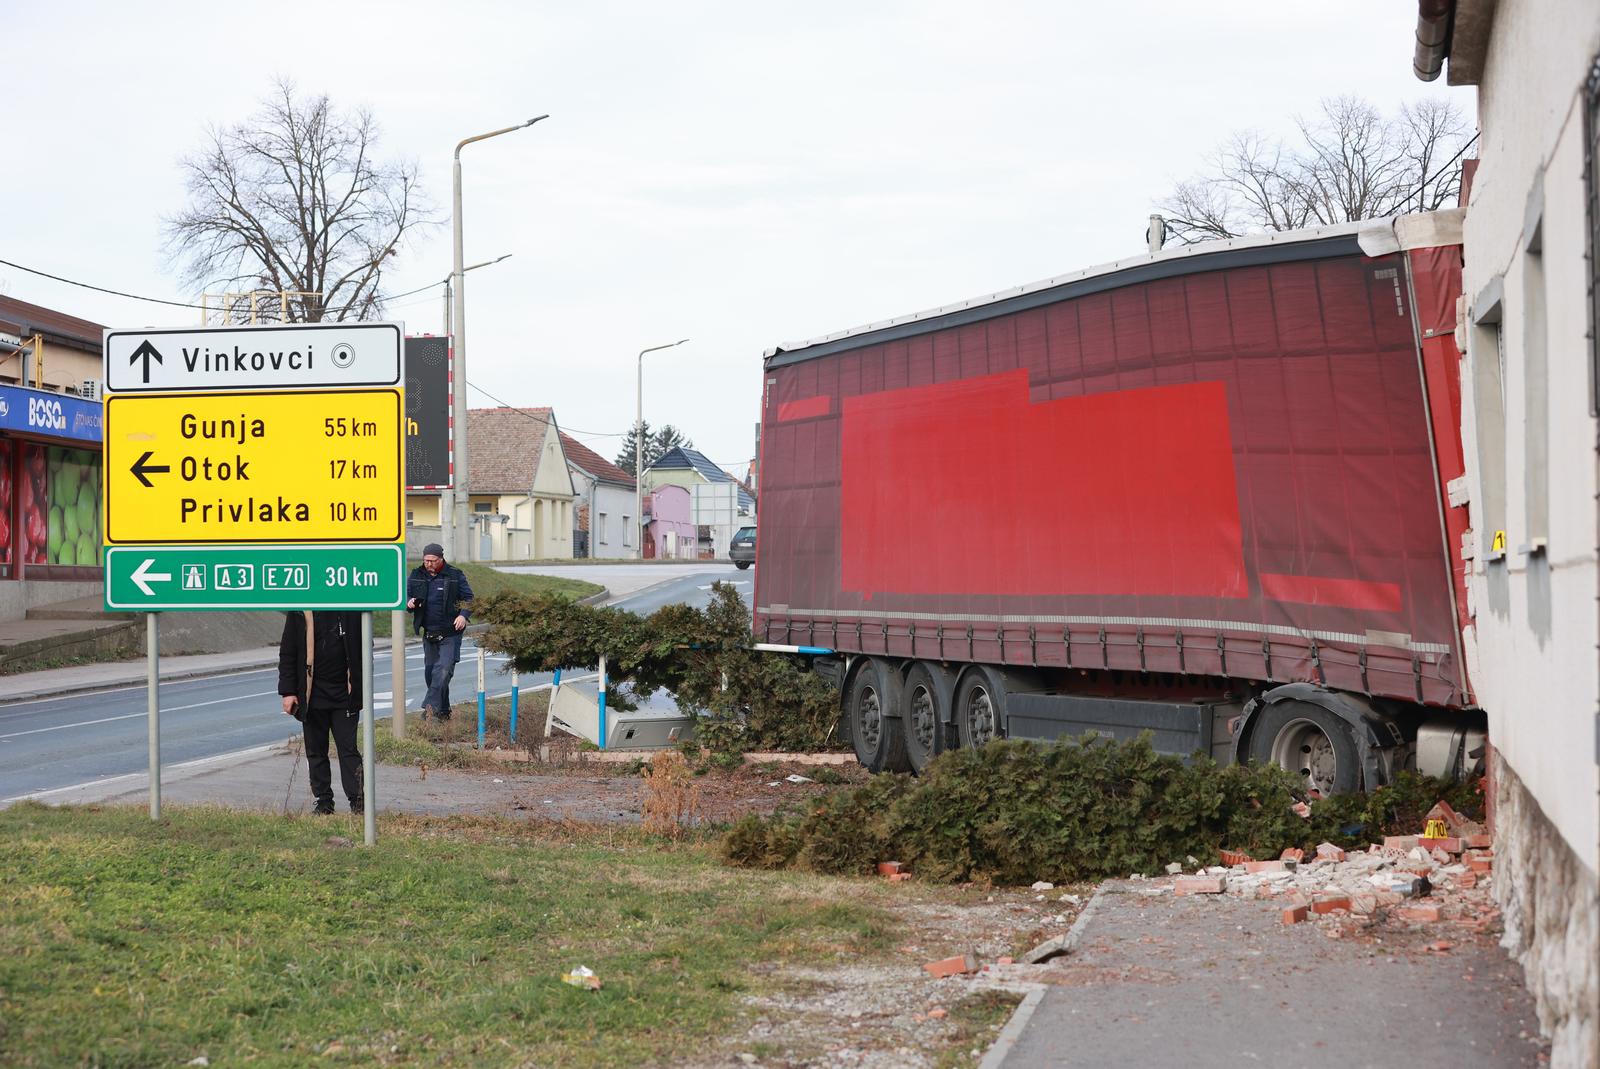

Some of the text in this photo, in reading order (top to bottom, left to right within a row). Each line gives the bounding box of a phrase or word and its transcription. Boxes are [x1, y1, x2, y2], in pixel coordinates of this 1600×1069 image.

[182, 345, 313, 372] Vinkovci
[181, 414, 377, 444] Gunja 55 km
[181, 455, 377, 481] Otok 17 km
[181, 497, 377, 523] Privlaka 10 km
[267, 568, 277, 586] E
[283, 568, 304, 587] 70
[325, 567, 347, 586] 30
[352, 567, 378, 586] km
